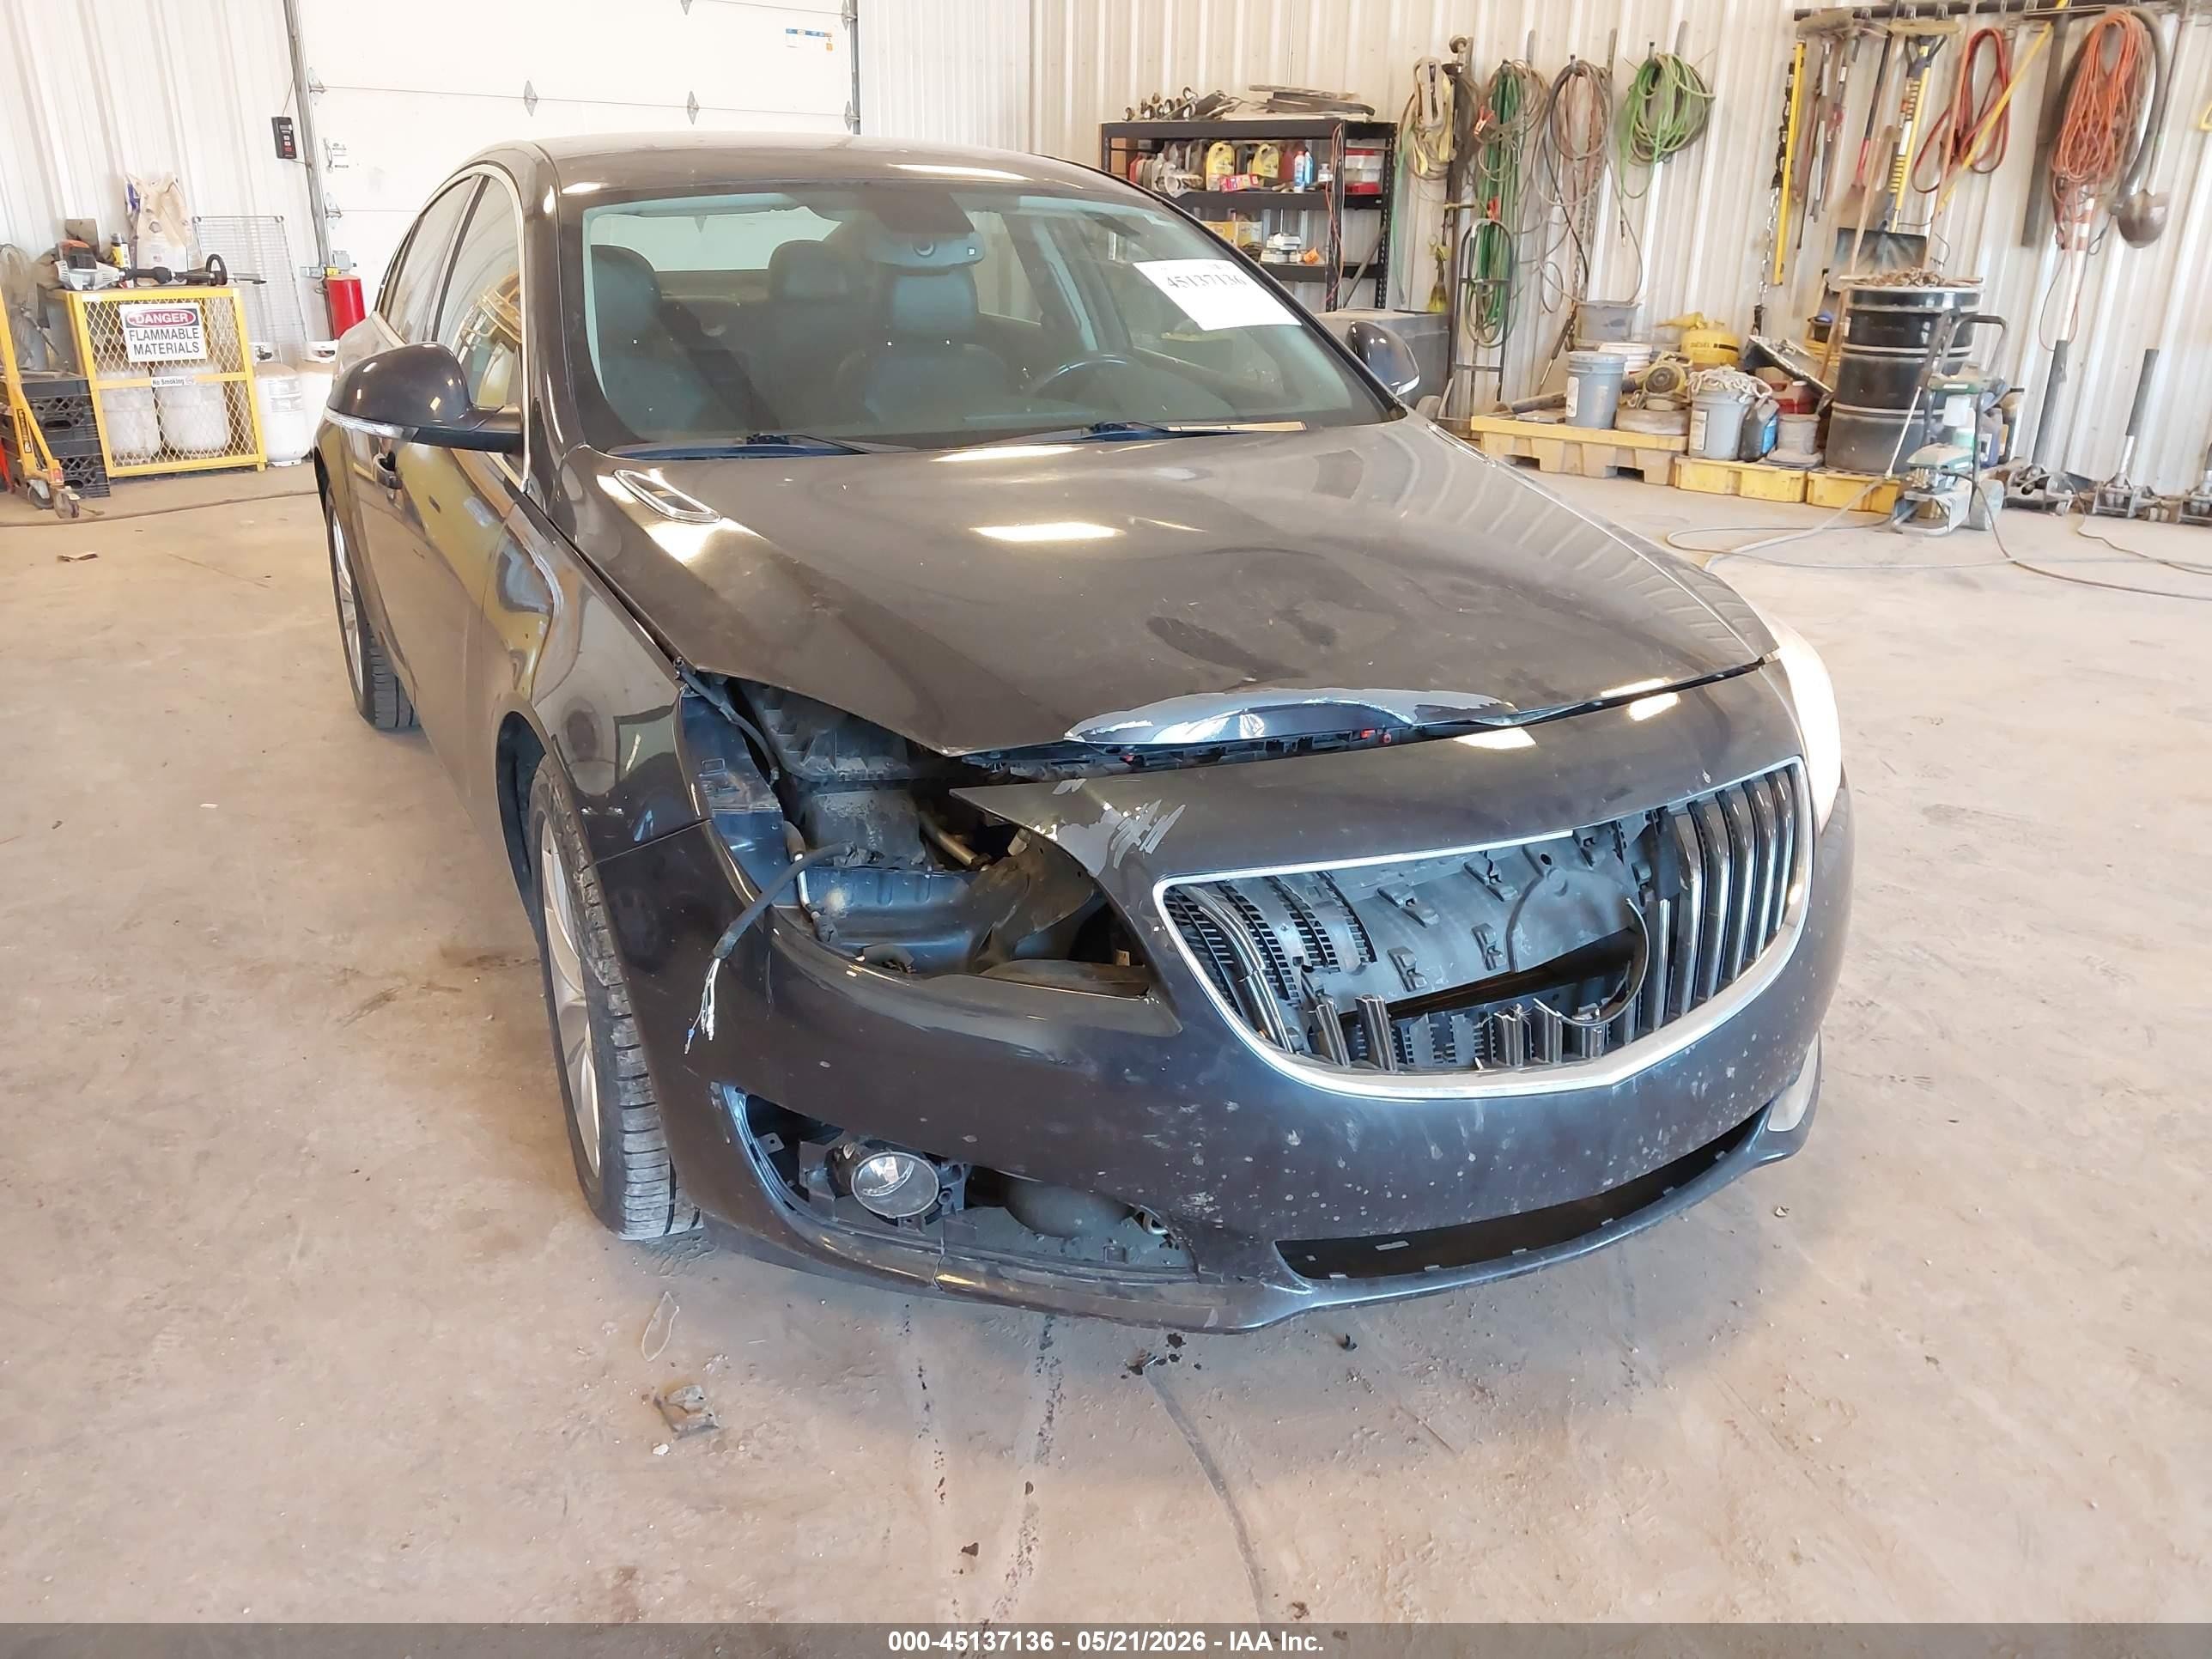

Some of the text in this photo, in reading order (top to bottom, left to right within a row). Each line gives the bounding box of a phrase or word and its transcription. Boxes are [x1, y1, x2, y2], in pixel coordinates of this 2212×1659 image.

[1167, 274, 1247, 288] 45137136
[136, 313, 188, 324] DANGER
[129, 328, 199, 341] FLAMMABLE
[134, 342, 199, 356] MATERIALS
